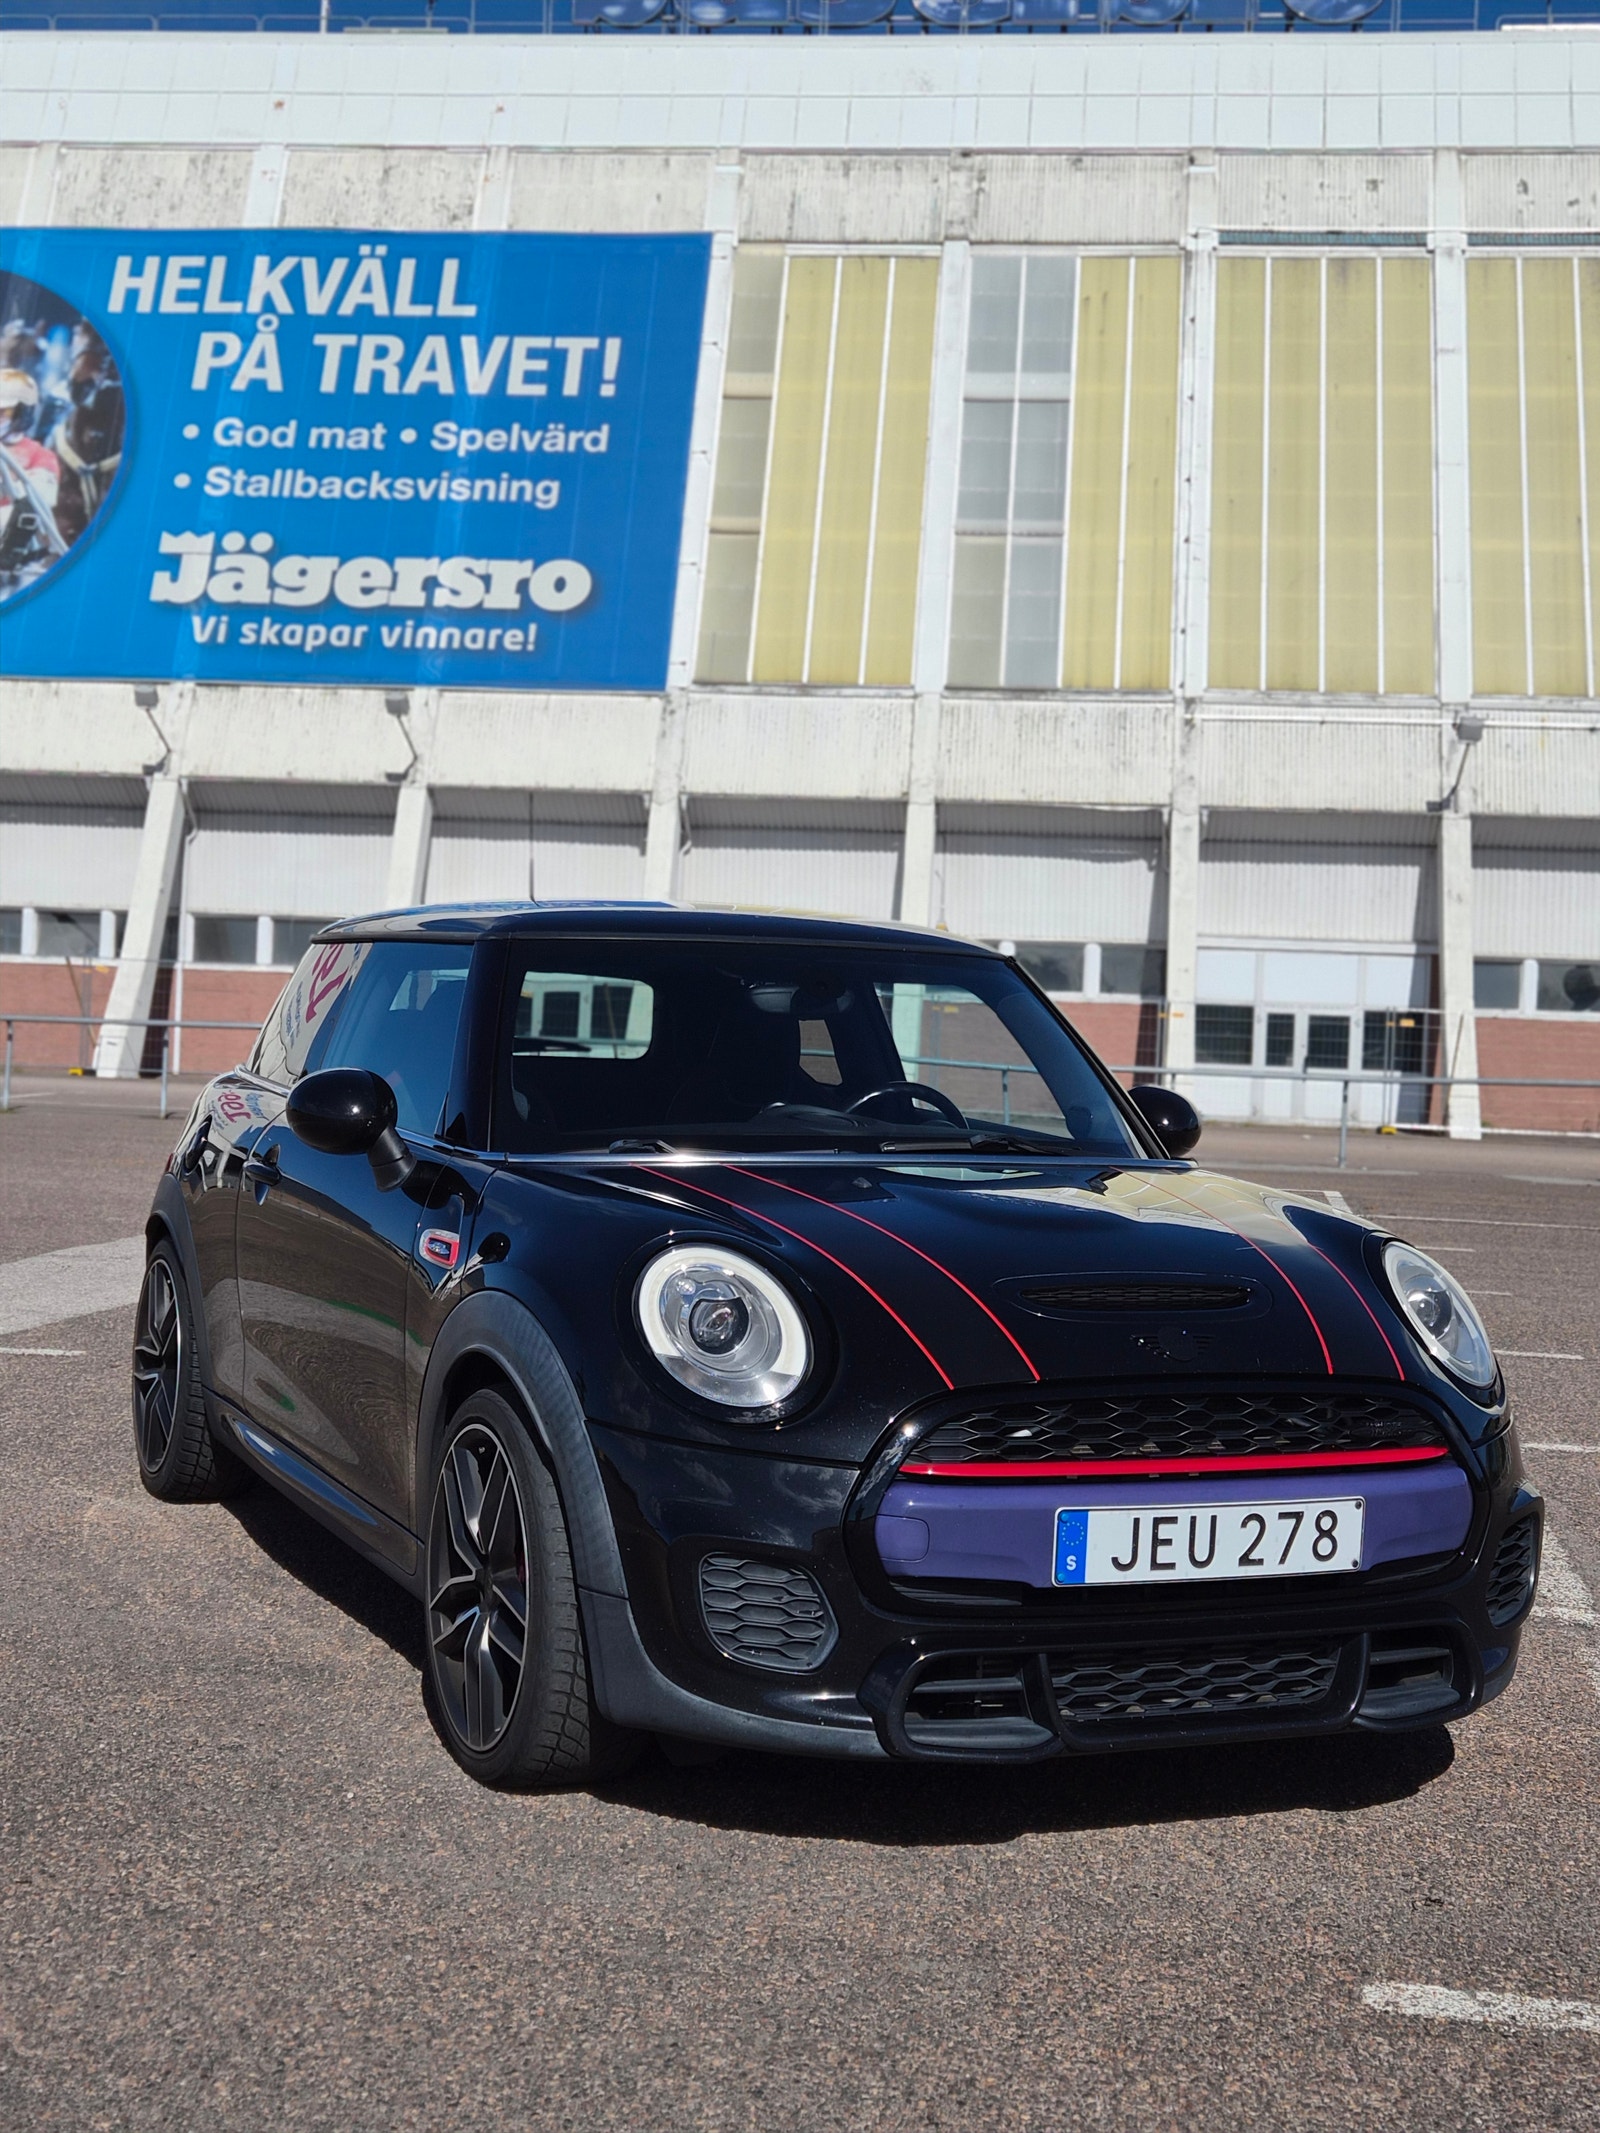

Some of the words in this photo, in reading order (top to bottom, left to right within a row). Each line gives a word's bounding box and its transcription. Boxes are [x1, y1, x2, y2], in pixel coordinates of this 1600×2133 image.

[107, 245, 477, 316] HELKVÄLL
[191, 313, 283, 391] PÅ
[313, 334, 621, 396] TRAVET!
[213, 417, 297, 448] God
[308, 422, 387, 450] mat
[430, 421, 609, 457] Spelvärd
[203, 466, 560, 509] Stallbacksvisning
[150, 531, 591, 611] Jägersro
[192, 615, 228, 644] Vi
[239, 616, 368, 652] skapar
[381, 620, 537, 651] vinnare!
[1066, 1555, 1077, 1571] S
[1111, 1515, 1217, 1571] JEU
[1238, 1510, 1338, 1566] 278
